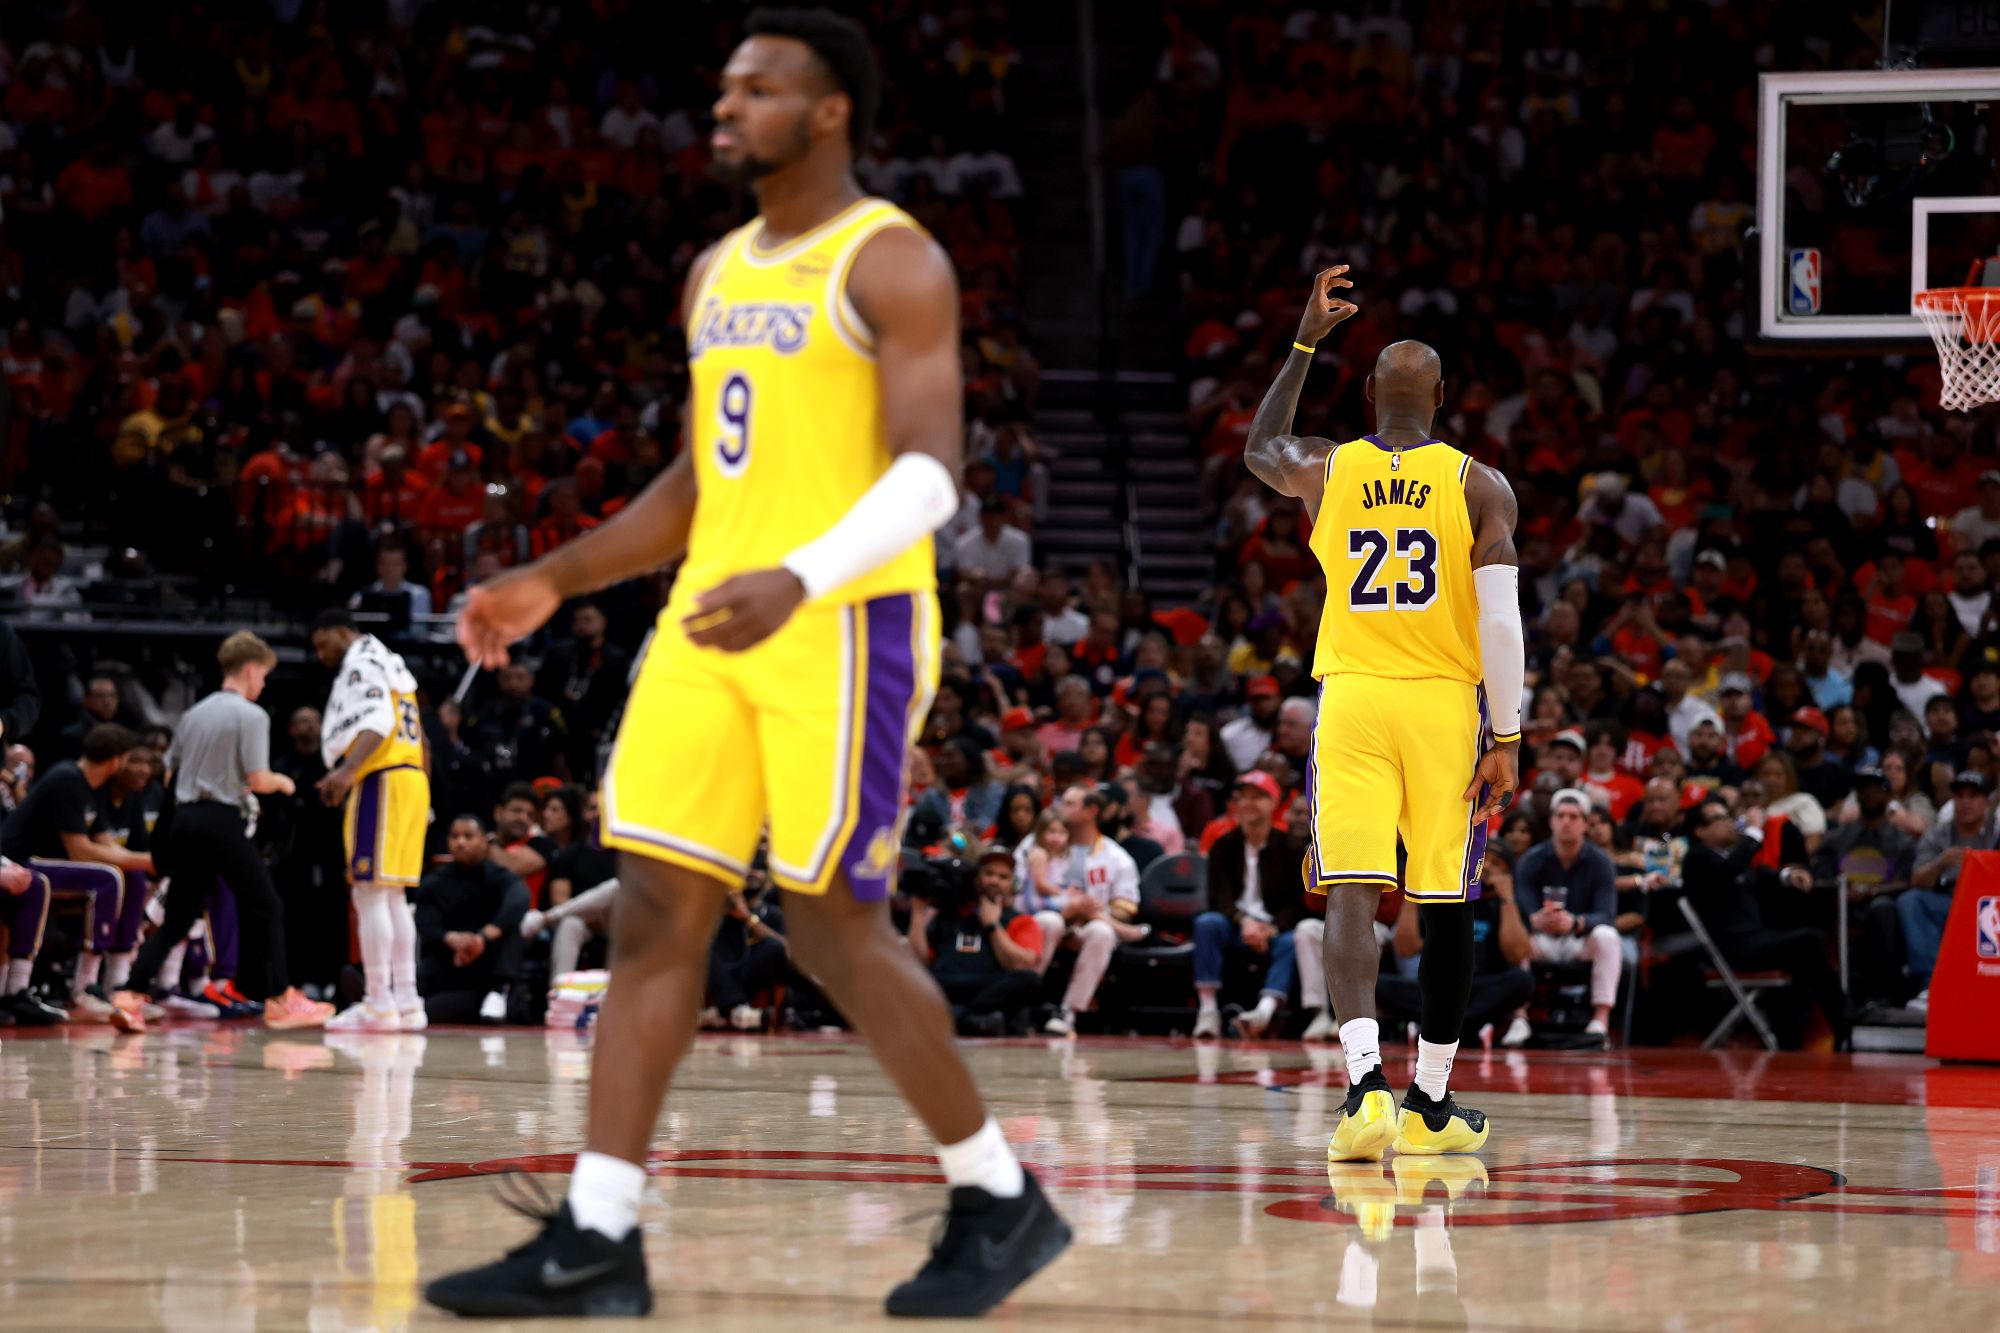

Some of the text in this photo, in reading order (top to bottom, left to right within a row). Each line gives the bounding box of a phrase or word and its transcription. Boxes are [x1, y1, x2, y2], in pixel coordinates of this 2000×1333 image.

[716, 372, 753, 474] 9
[1362, 478, 1431, 510] JAMES
[1348, 528, 1439, 612] 23
